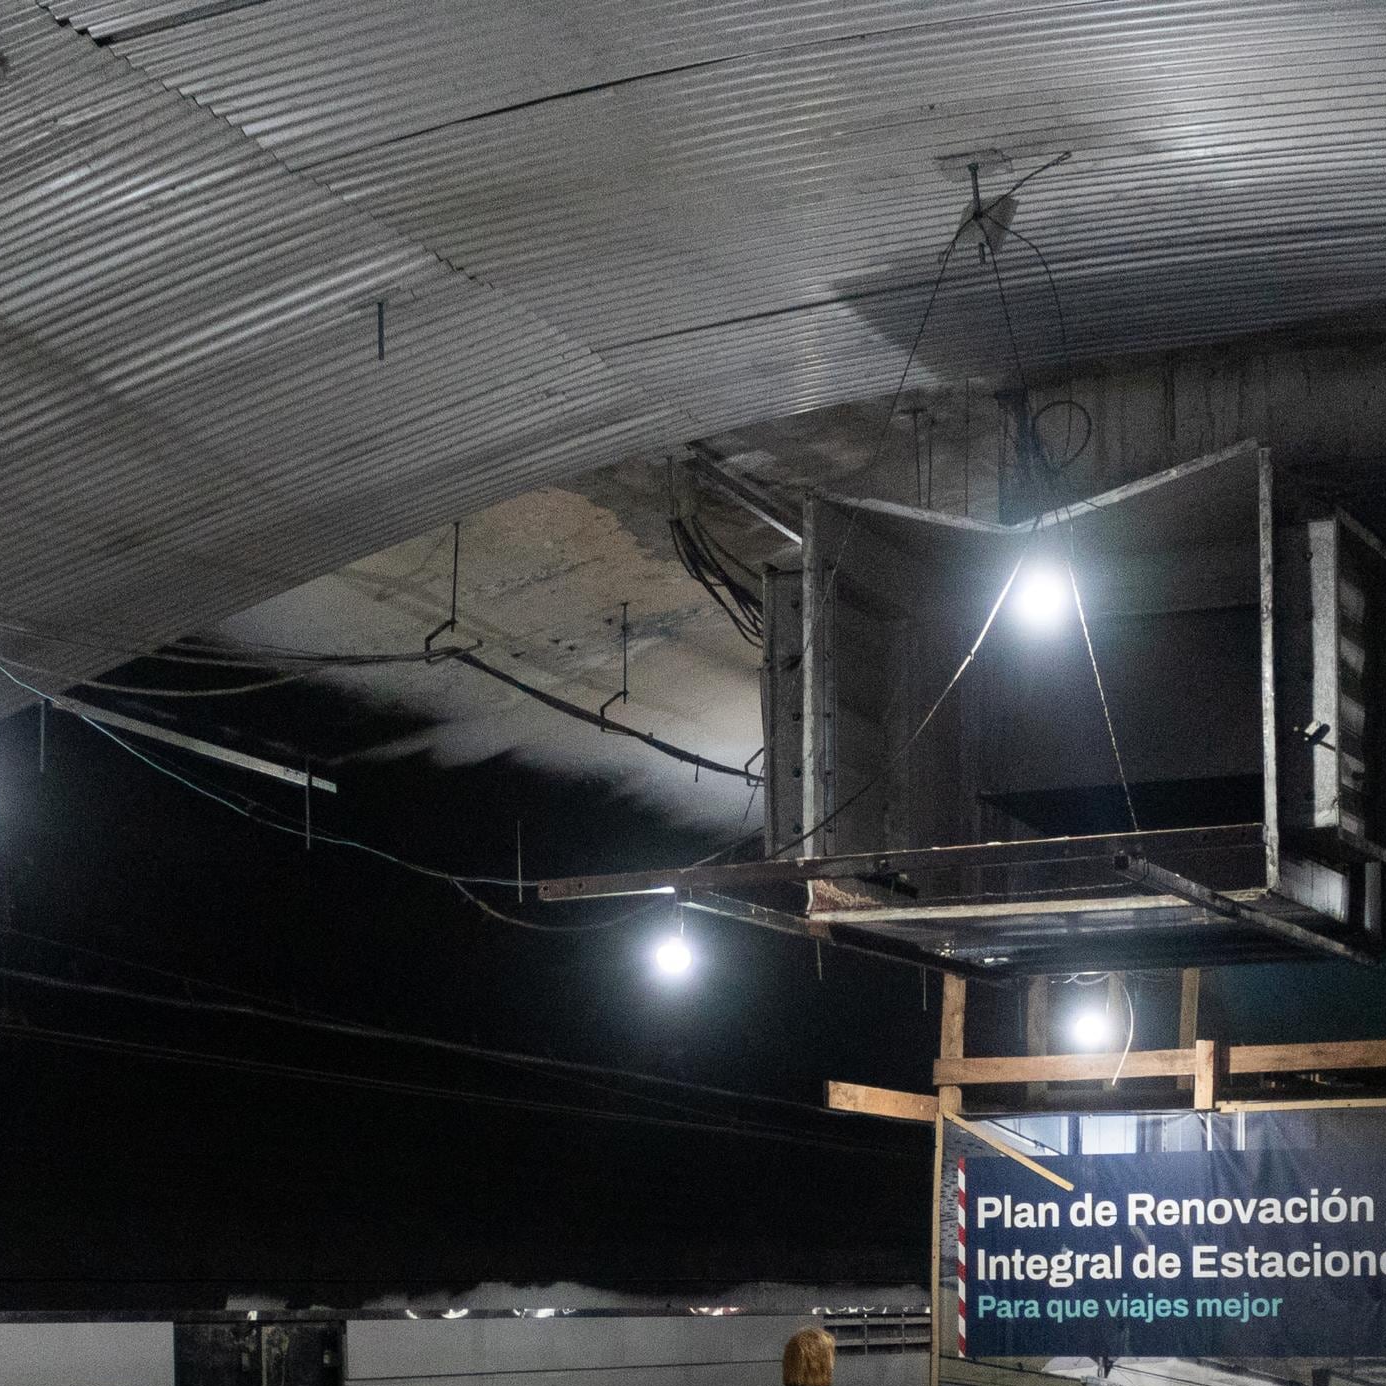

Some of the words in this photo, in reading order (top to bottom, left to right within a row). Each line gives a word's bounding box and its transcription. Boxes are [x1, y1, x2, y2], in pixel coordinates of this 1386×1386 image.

[977, 1194, 1060, 1229] Plan
[1069, 1192, 1118, 1227] de
[1127, 1187, 1375, 1227] Renovación
[977, 1245, 1122, 1288] Integral
[1132, 1244, 1182, 1279] de
[977, 1295, 1041, 1319] Para
[1046, 1297, 1099, 1323] que
[1104, 1293, 1190, 1323] viajes
[1196, 1292, 1284, 1323] mejor
